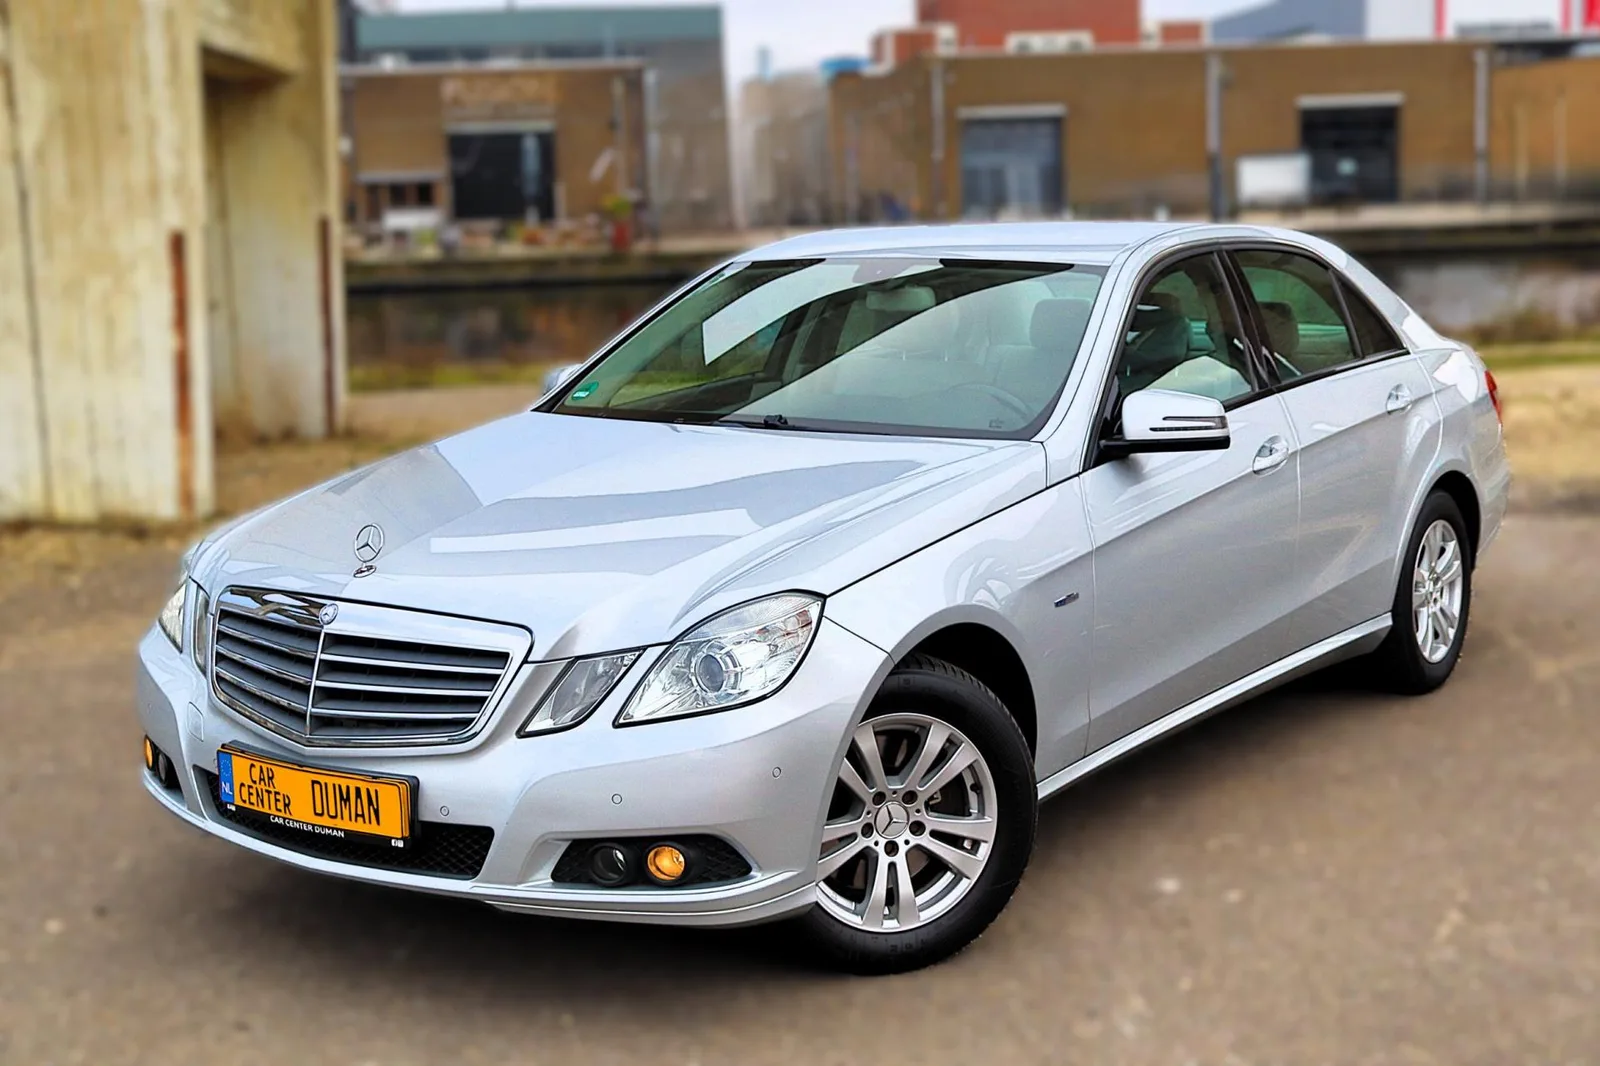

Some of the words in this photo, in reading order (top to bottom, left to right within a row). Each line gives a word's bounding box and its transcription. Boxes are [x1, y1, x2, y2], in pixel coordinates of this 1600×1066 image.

[222, 781, 233, 795] NL
[249, 763, 276, 789] CAR
[239, 782, 293, 816] CENTER
[311, 780, 380, 826] DUMAN
[270, 815, 284, 825] CAR
[285, 819, 313, 832] CENTER
[314, 826, 345, 838] DUMAN
